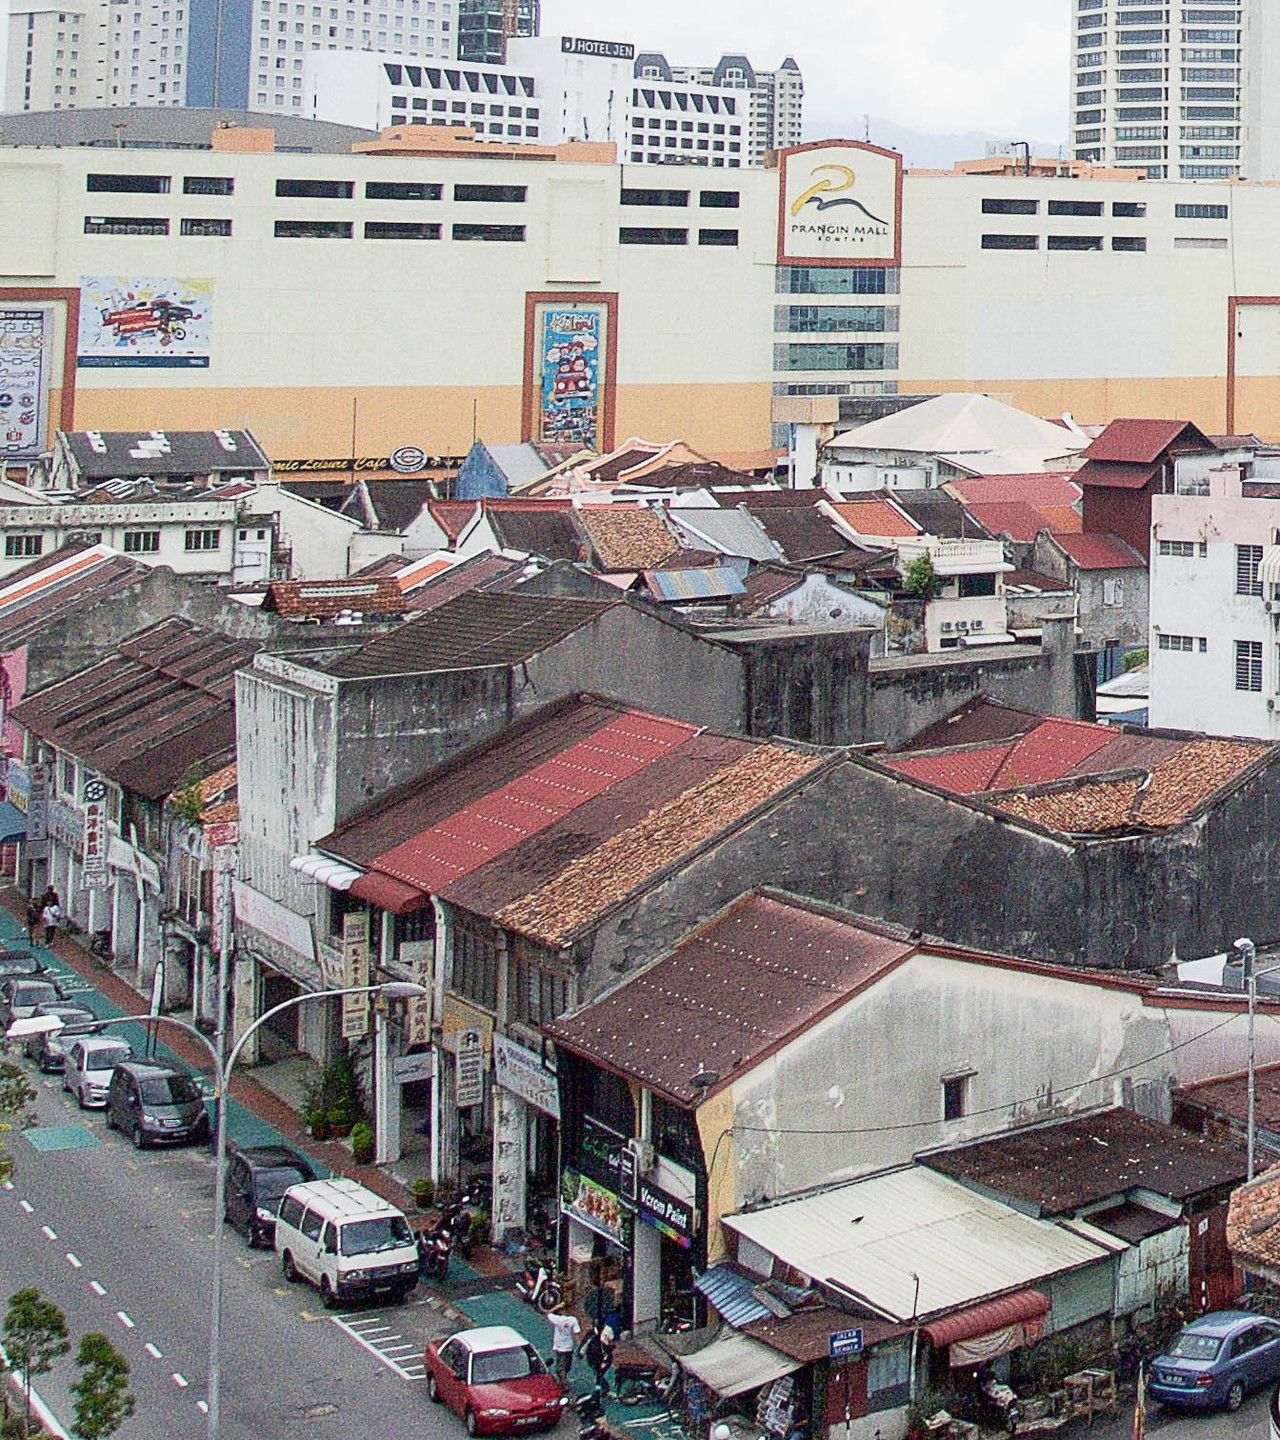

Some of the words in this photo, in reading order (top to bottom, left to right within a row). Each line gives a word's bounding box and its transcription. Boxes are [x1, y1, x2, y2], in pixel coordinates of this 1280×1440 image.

[577, 41, 612, 55] HOTEL
[613, 44, 633, 57] JEN
[791, 224, 849, 234] PRANGIN
[854, 226, 889, 236] MALL
[300, 459, 348, 470] Leisure
[353, 457, 387, 471] Cafe
